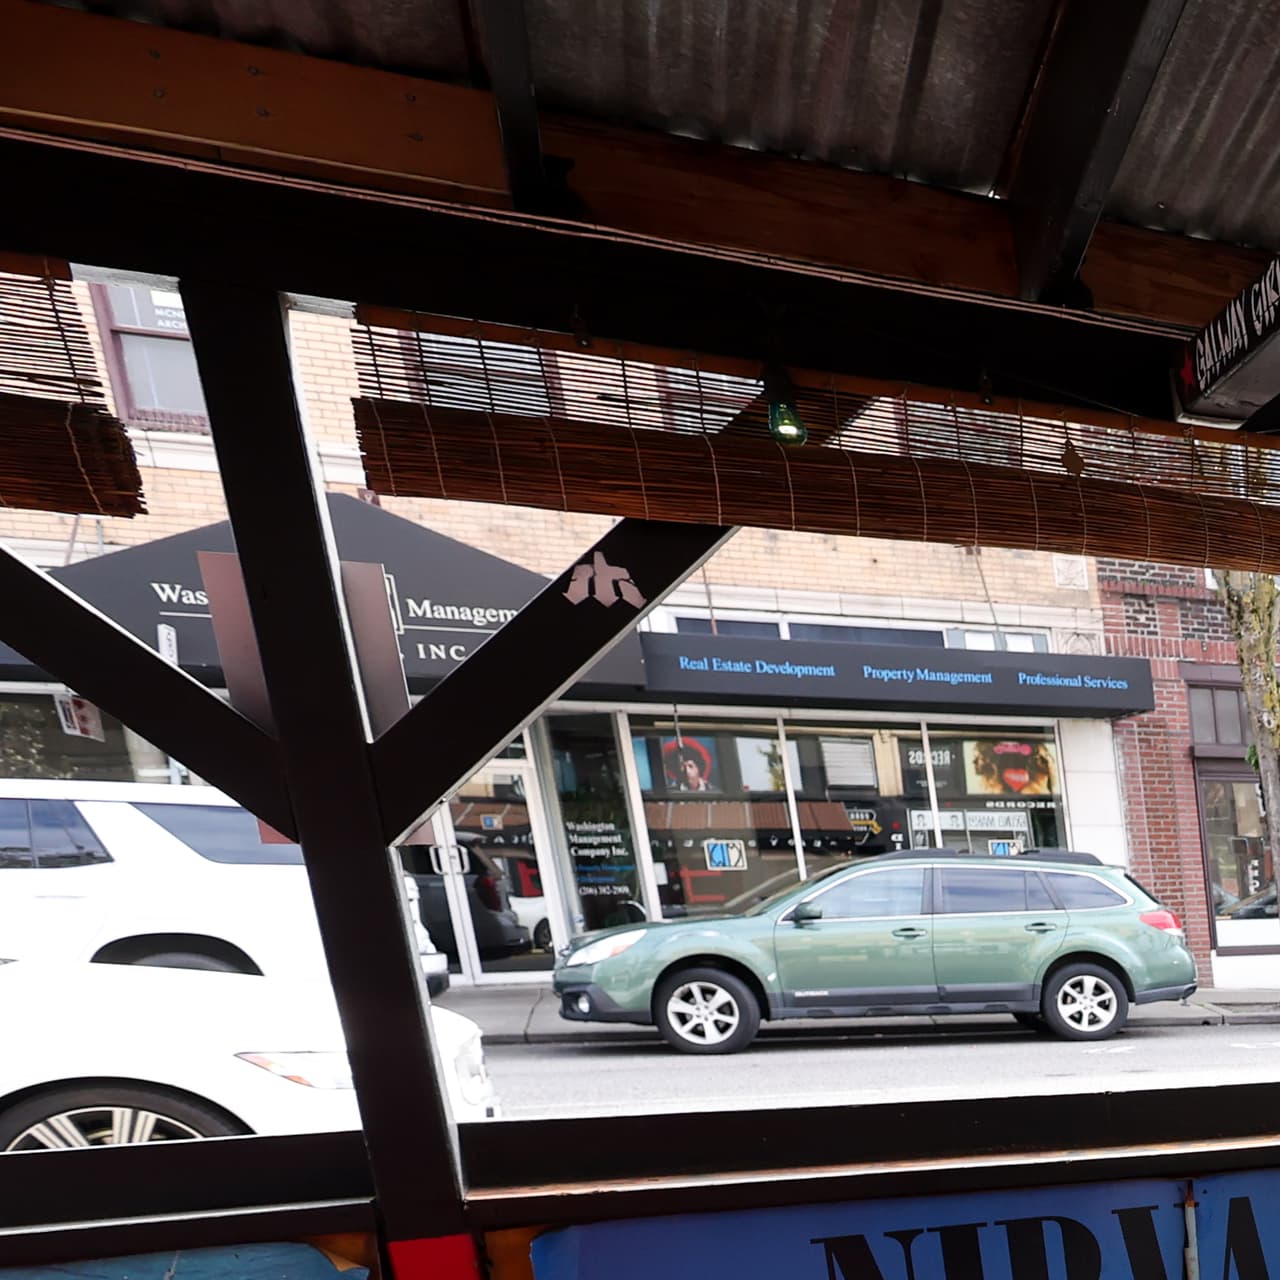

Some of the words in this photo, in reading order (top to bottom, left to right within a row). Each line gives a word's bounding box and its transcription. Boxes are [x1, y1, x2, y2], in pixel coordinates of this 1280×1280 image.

[679, 655, 708, 671] Real
[712, 658, 752, 673] Estate
[755, 659, 835, 678] Development
[862, 665, 915, 682] Property
[916, 669, 993, 685] Management
[1017, 671, 1082, 688] Professional
[1083, 675, 1129, 690] Services
